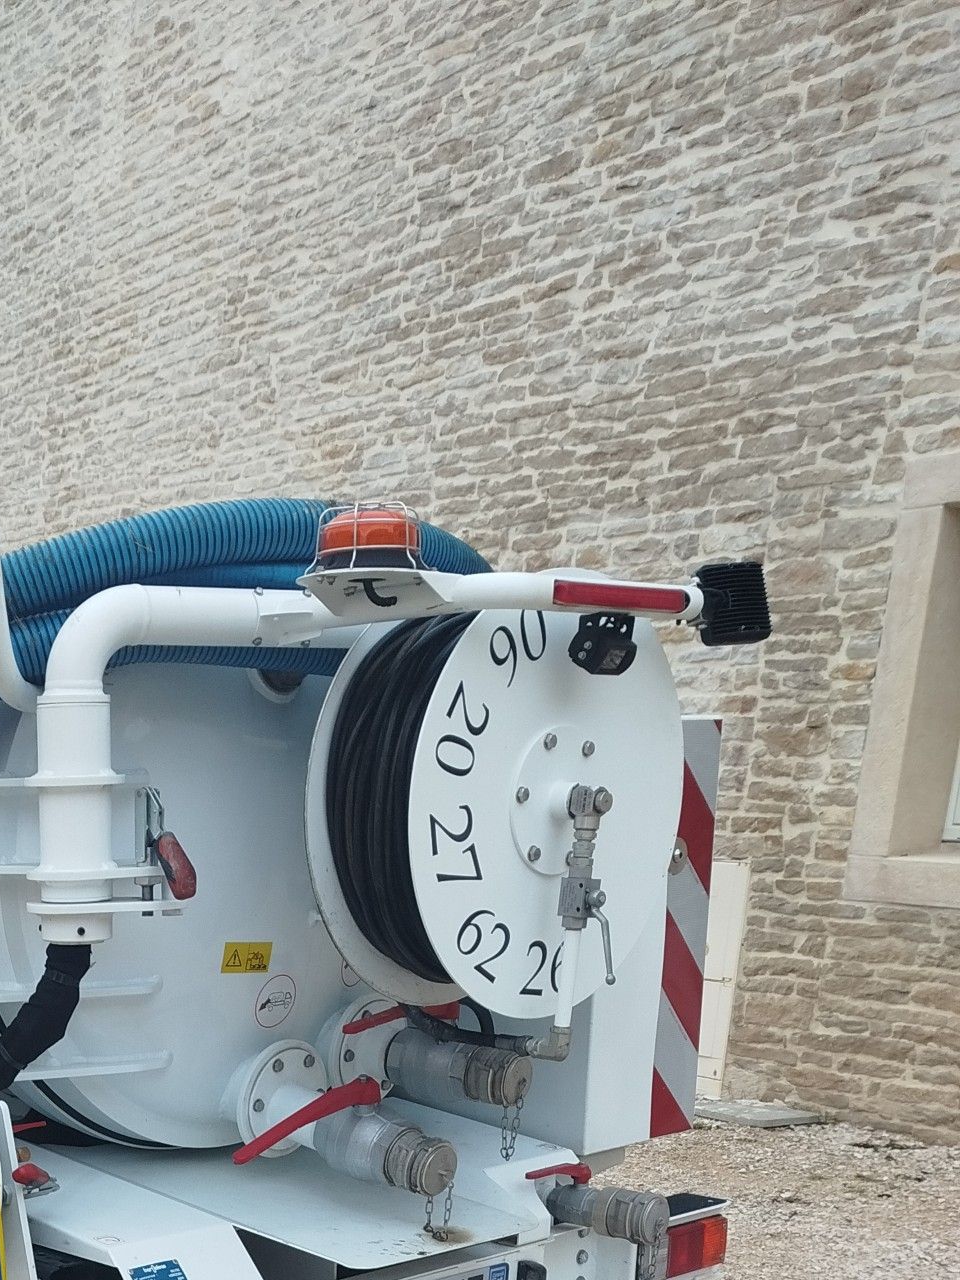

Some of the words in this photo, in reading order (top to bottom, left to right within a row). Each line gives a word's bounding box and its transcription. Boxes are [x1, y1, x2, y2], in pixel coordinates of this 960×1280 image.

[489, 608, 547, 688] 06
[435, 680, 490, 777] 20
[429, 804, 483, 883] 27
[456, 909, 511, 984] 62
